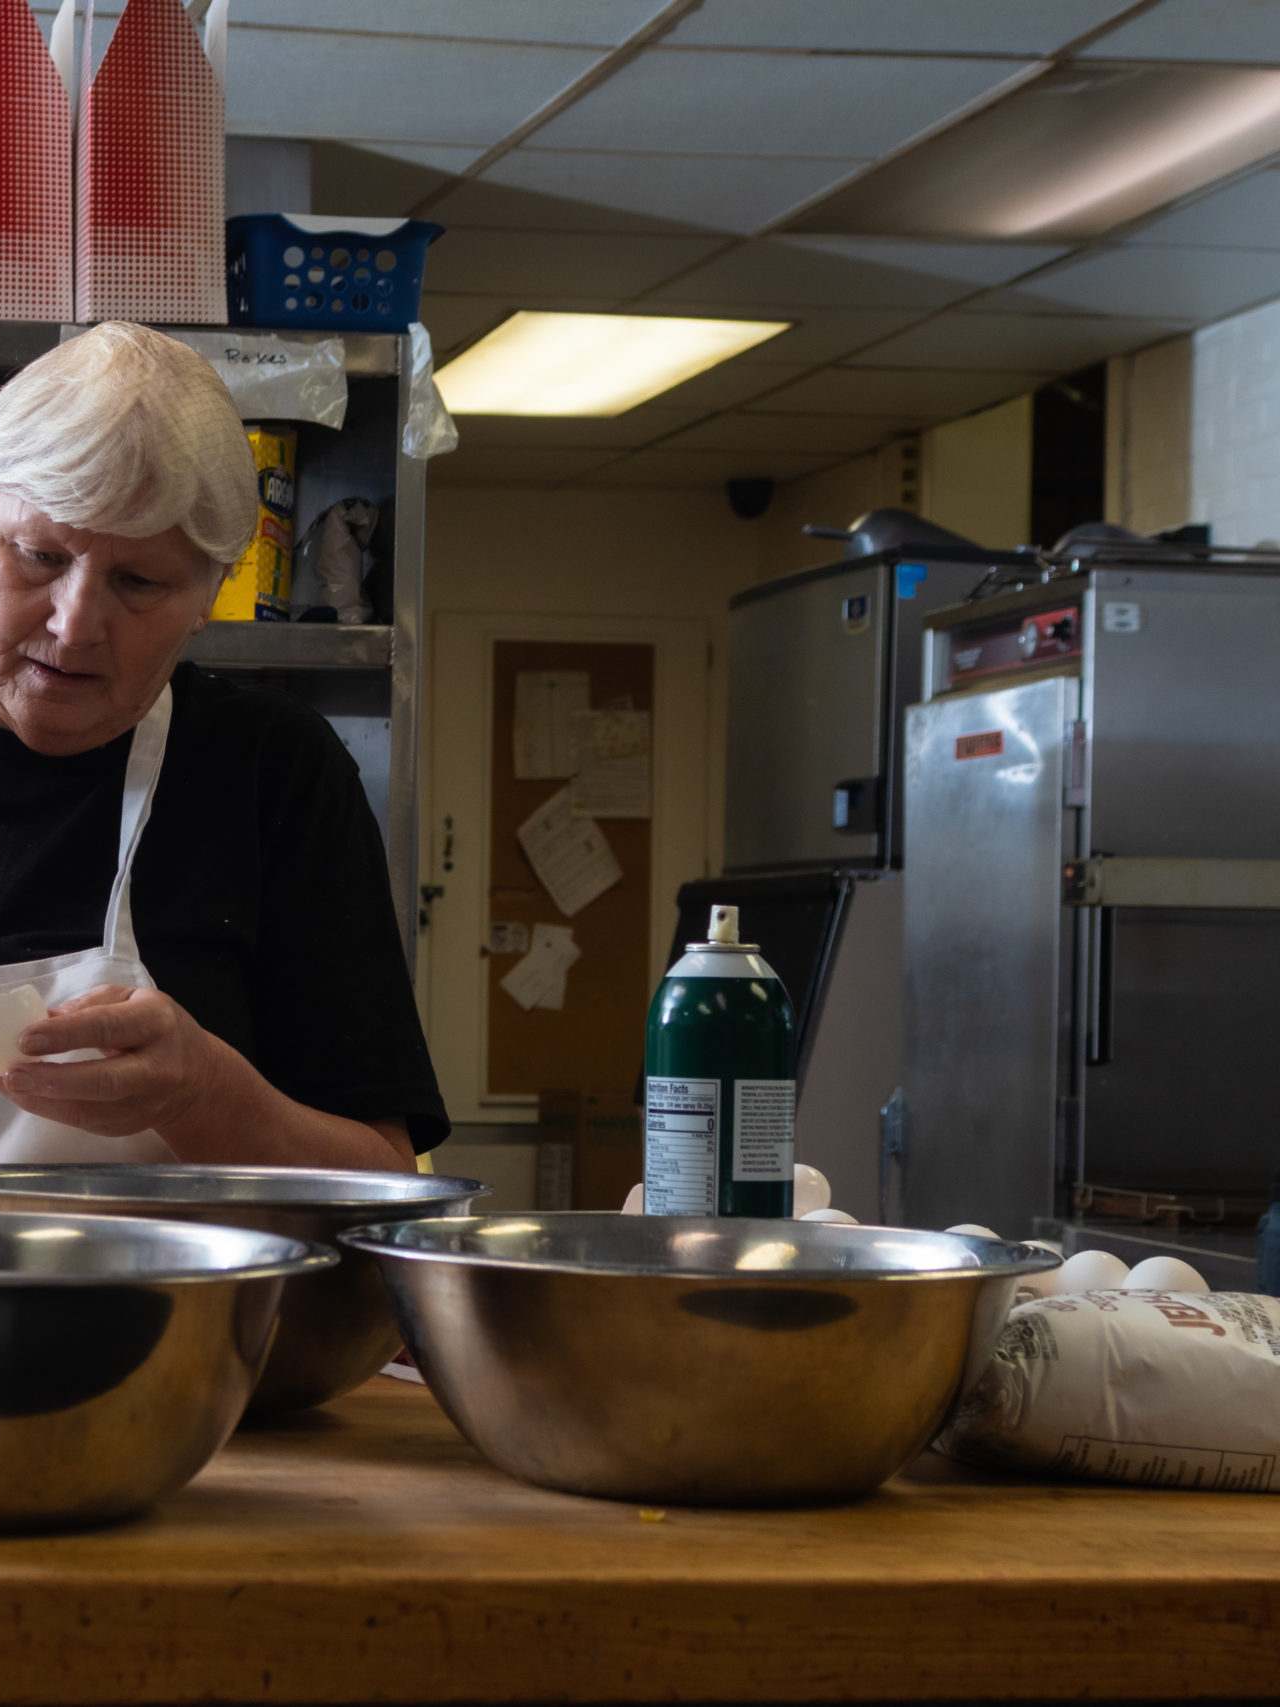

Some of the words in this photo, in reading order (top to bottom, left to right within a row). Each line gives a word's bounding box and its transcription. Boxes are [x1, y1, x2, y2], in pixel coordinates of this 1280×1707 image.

[225, 348, 287, 365] Boxes
[670, 1083, 688, 1094] Facts
[707, 1118, 715, 1131] 0
